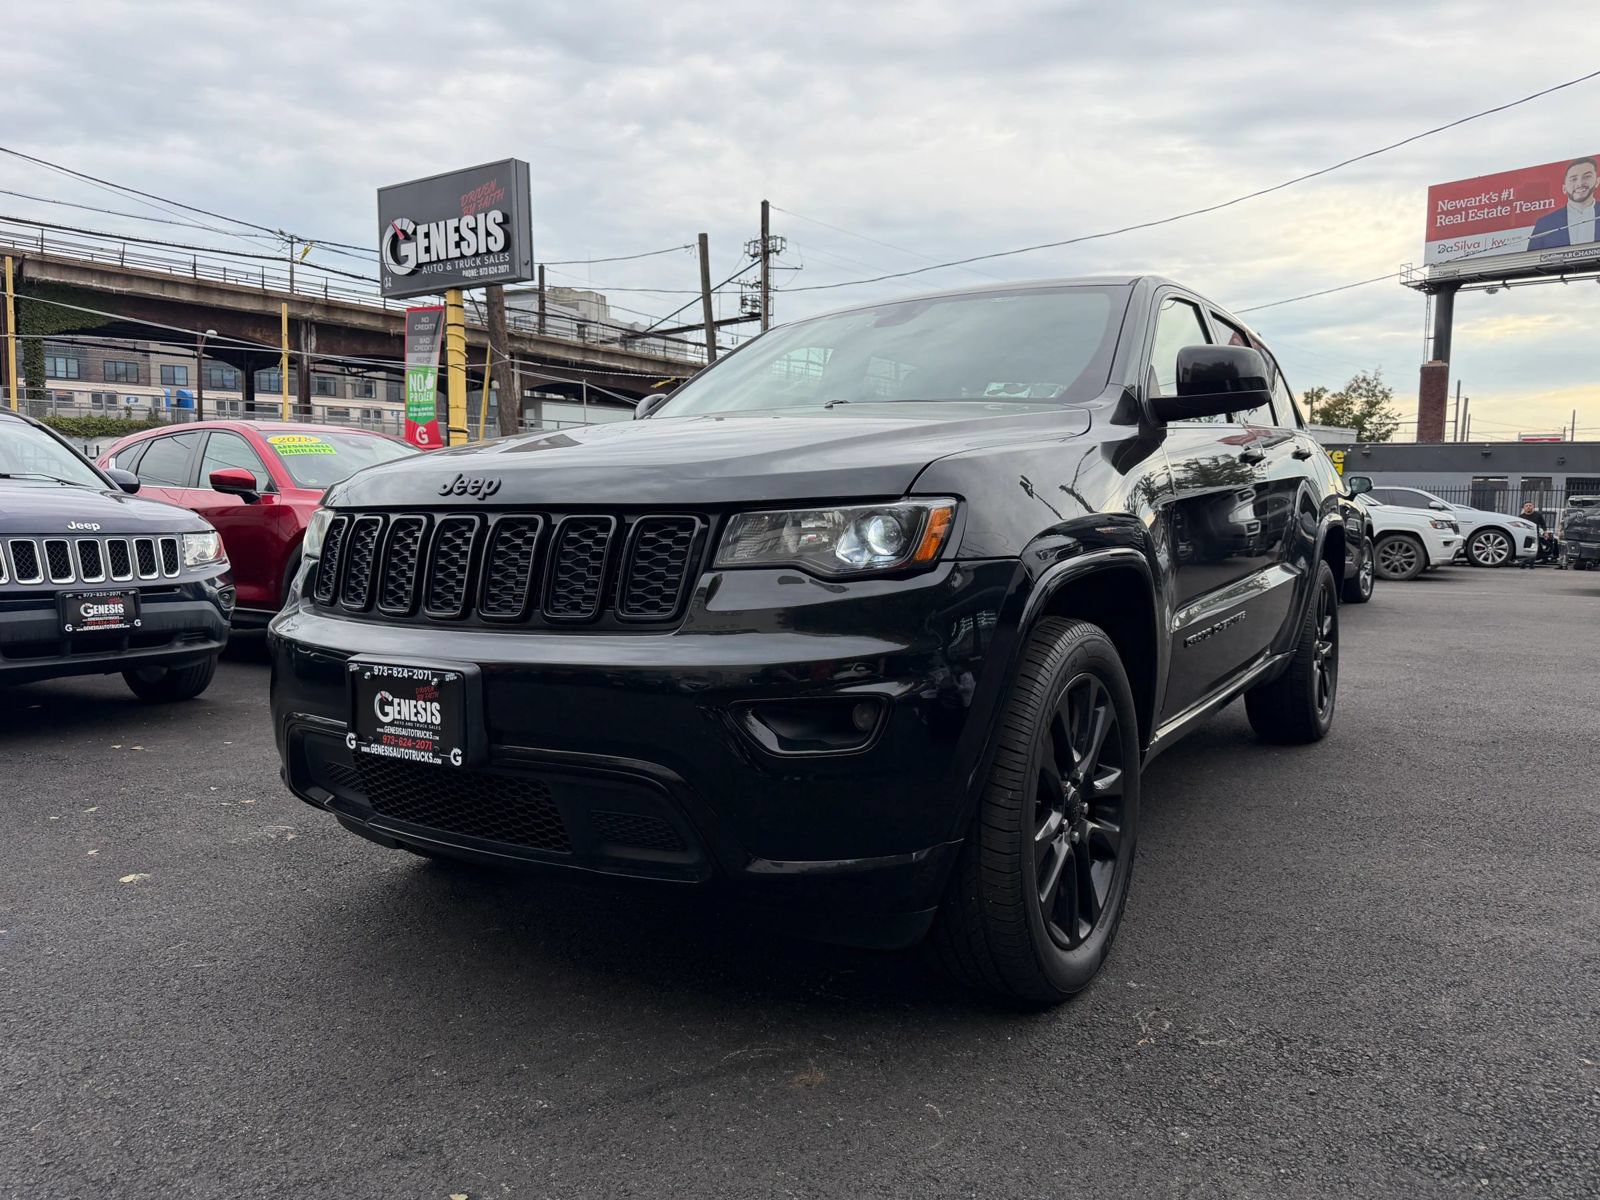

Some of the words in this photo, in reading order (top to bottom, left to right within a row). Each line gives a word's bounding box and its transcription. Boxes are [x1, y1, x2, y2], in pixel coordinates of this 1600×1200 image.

[1437, 191, 1499, 212] Newark's
[1501, 188, 1515, 201] #1
[1436, 211, 1466, 227] Real
[1468, 206, 1511, 221] Estate
[1513, 198, 1555, 214] Team
[382, 209, 506, 276] GENESIS
[1437, 240, 1481, 254] DaSilva
[1491, 238, 1507, 248] kw
[422, 263, 443, 274] AUTO
[446, 262, 453, 271] &
[454, 256, 482, 269] TRUCK
[484, 253, 509, 265] SALES
[409, 373, 424, 392] NO
[416, 426, 429, 445] G
[438, 473, 502, 501] Jeep
[67, 520, 101, 532] Jeep
[80, 603, 124, 617] GENESIS
[65, 624, 73, 632] G
[134, 619, 142, 627] G
[373, 665, 432, 681] 973-624-2071
[374, 691, 441, 725] GENESIS
[346, 732, 356, 749] G
[382, 735, 433, 750] 973-624-2071
[450, 747, 462, 767] G
